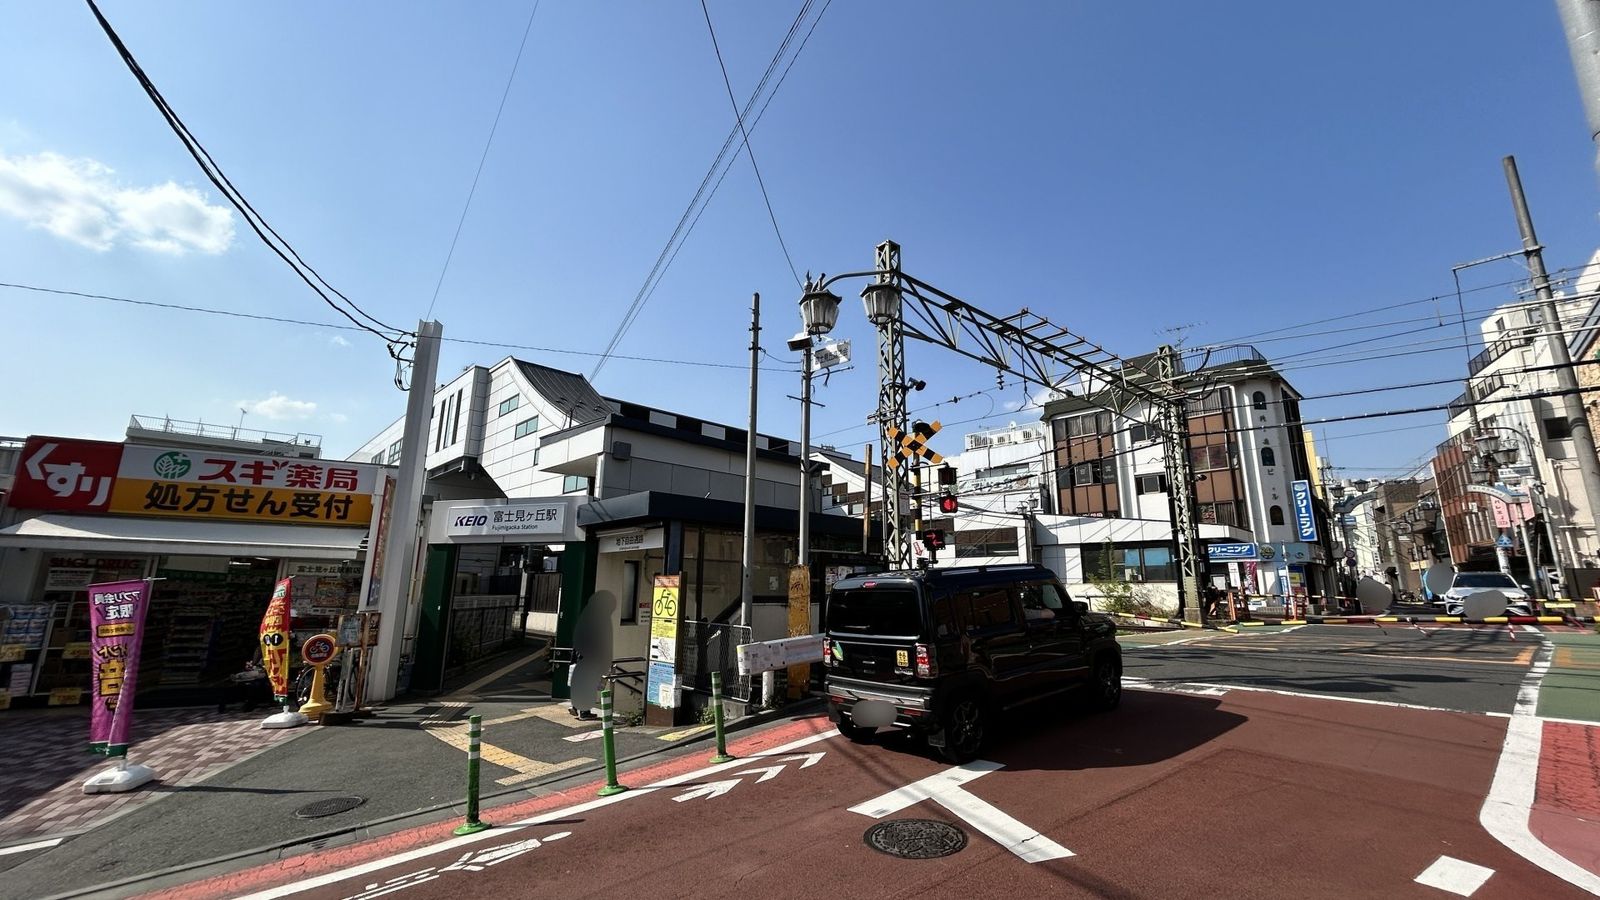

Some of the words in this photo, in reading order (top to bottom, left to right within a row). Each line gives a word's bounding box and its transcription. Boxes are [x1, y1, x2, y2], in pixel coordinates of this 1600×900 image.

[24, 443, 112, 506] くすり
[198, 458, 359, 491] スギ薬局
[143, 482, 353, 520] 処方せん受付
[493, 508, 557, 523] 富士見ヶ丘駅
[1295, 491, 1313, 537] クリーニング
[454, 515, 488, 527] KEIO
[1207, 545, 1251, 554] クリーニング
